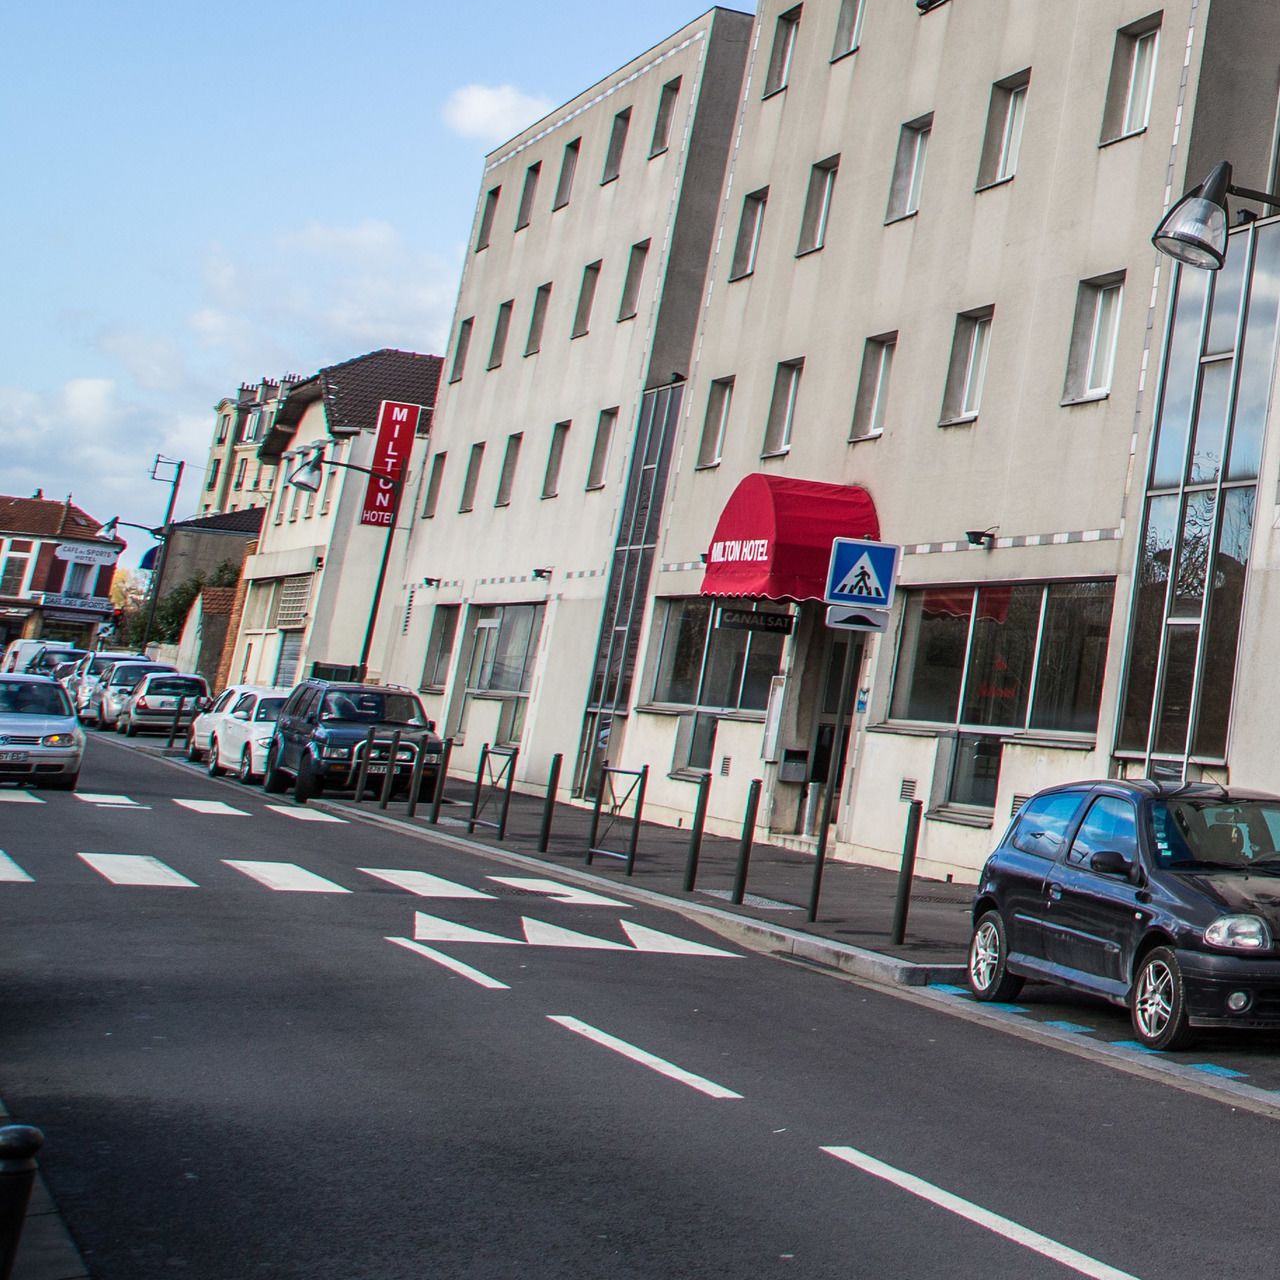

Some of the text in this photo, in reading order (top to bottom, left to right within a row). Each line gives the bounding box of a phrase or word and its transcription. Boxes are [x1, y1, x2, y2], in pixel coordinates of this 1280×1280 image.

[376, 407, 408, 507] MILTON
[86, 548, 113, 558] SPORTS
[711, 539, 768, 563] MILTON HOTEL
